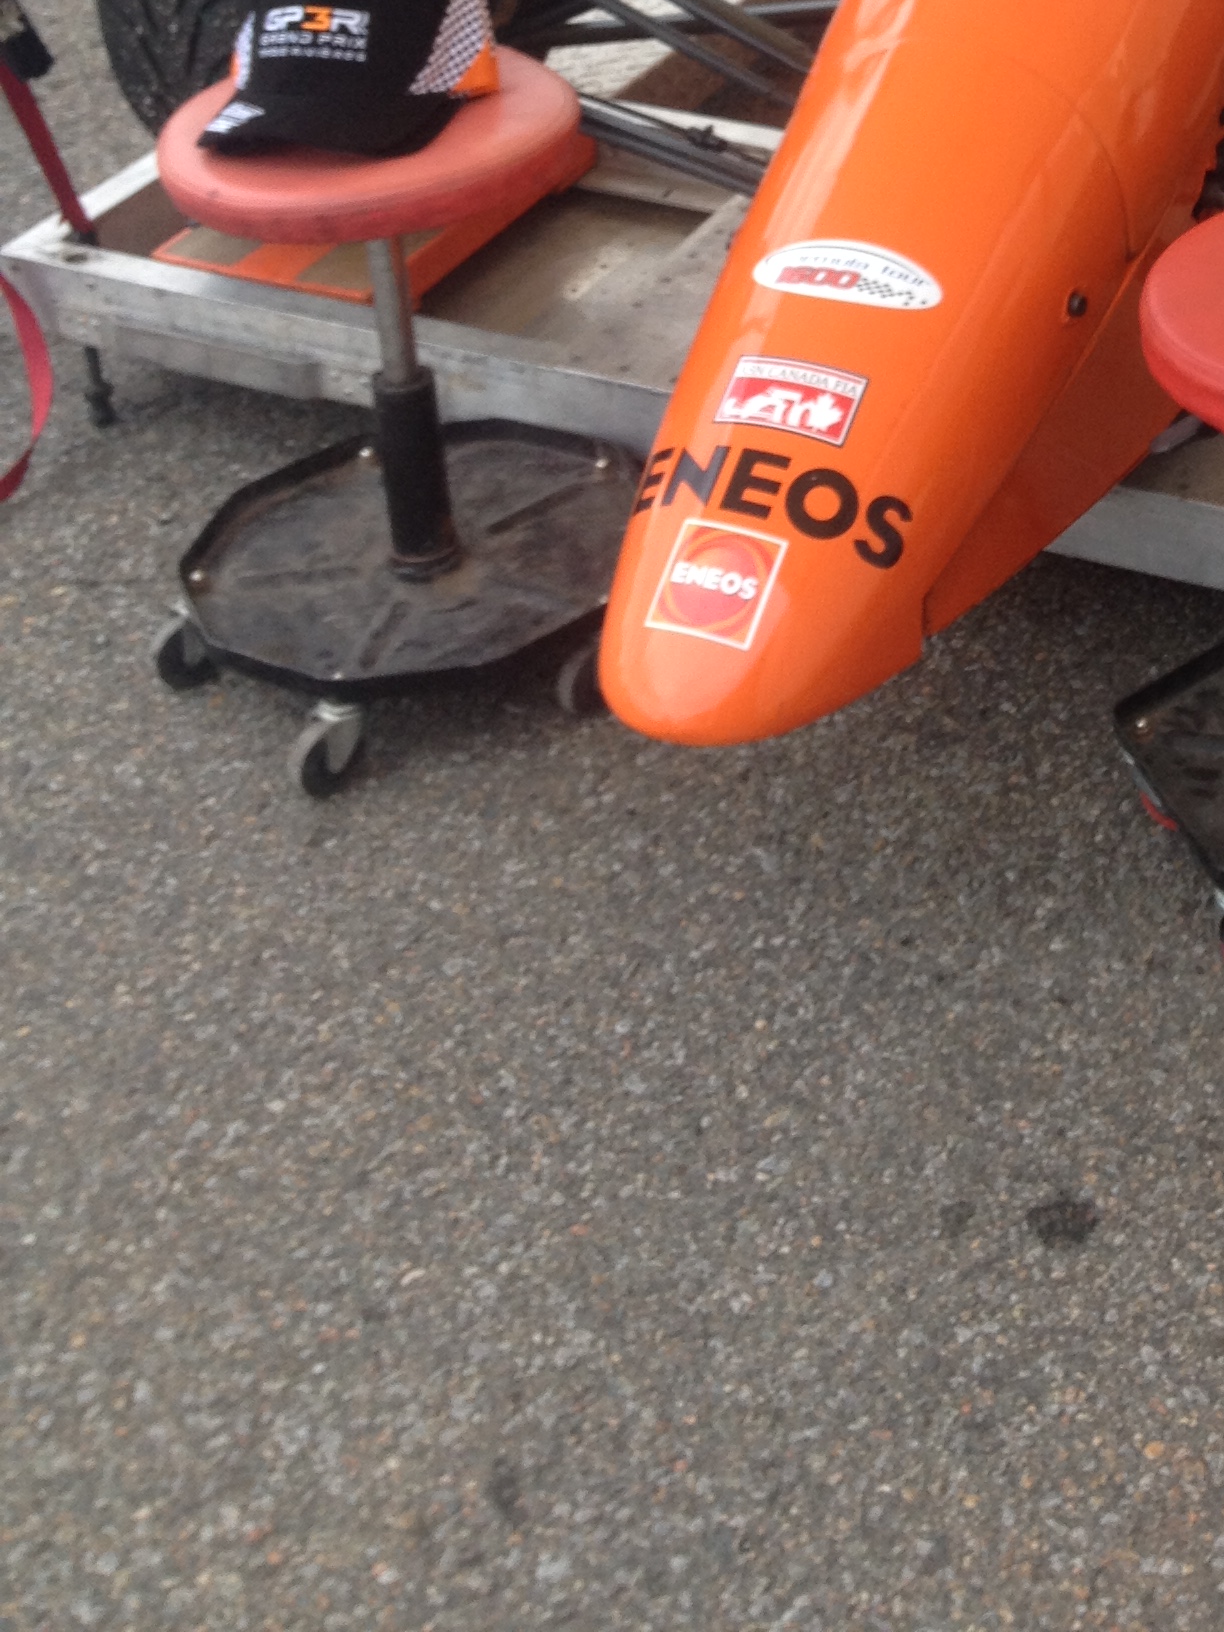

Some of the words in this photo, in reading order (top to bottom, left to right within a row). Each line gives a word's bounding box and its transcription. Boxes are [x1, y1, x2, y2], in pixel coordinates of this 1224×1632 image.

[767, 367, 829, 388] CANADA
[833, 380, 858, 397] FIA
[635, 446, 913, 568] ENEOS
[670, 561, 758, 599] ENEOS
